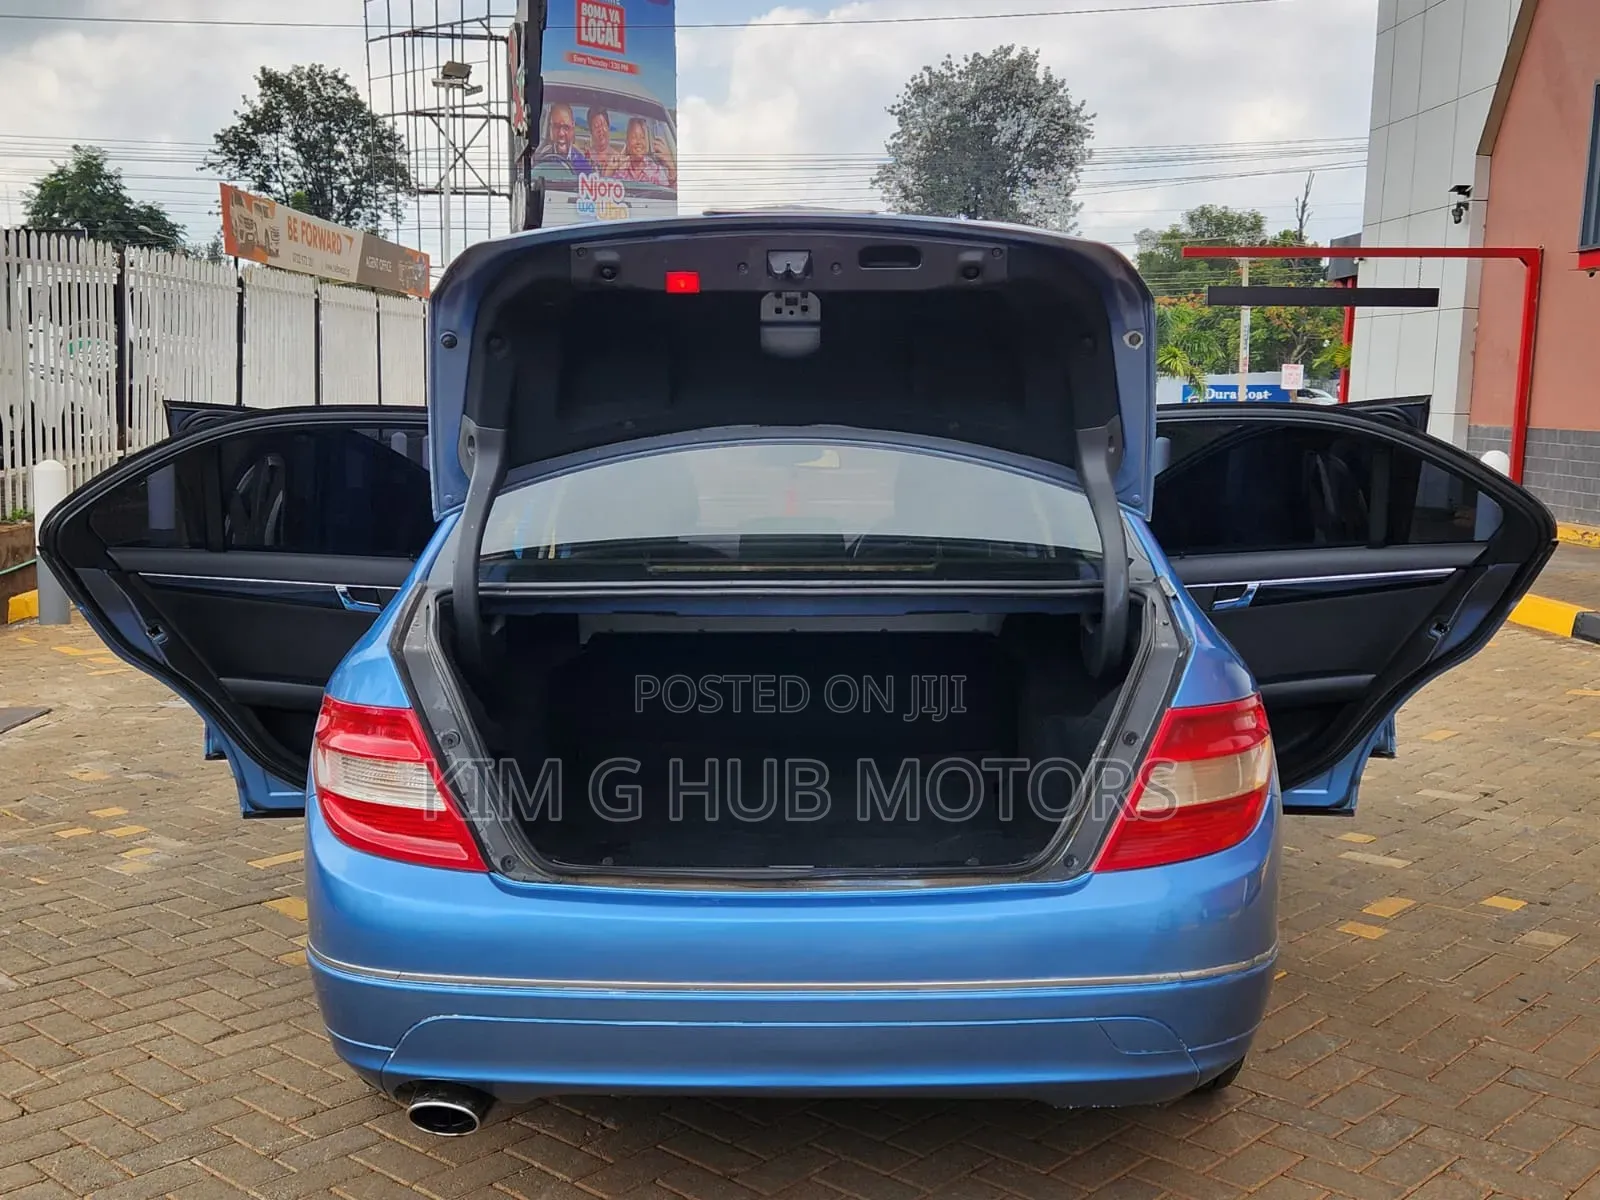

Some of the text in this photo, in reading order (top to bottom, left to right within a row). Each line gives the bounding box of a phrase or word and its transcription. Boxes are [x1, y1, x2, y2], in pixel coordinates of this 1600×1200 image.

[581, 3, 620, 23] BOMA YA
[581, 17, 621, 48] LOCAL
[581, 176, 623, 201] Njoro
[578, 201, 595, 213] wa
[287, 215, 343, 256] BE FORWARD
[1205, 388, 1272, 400] Duraoat
